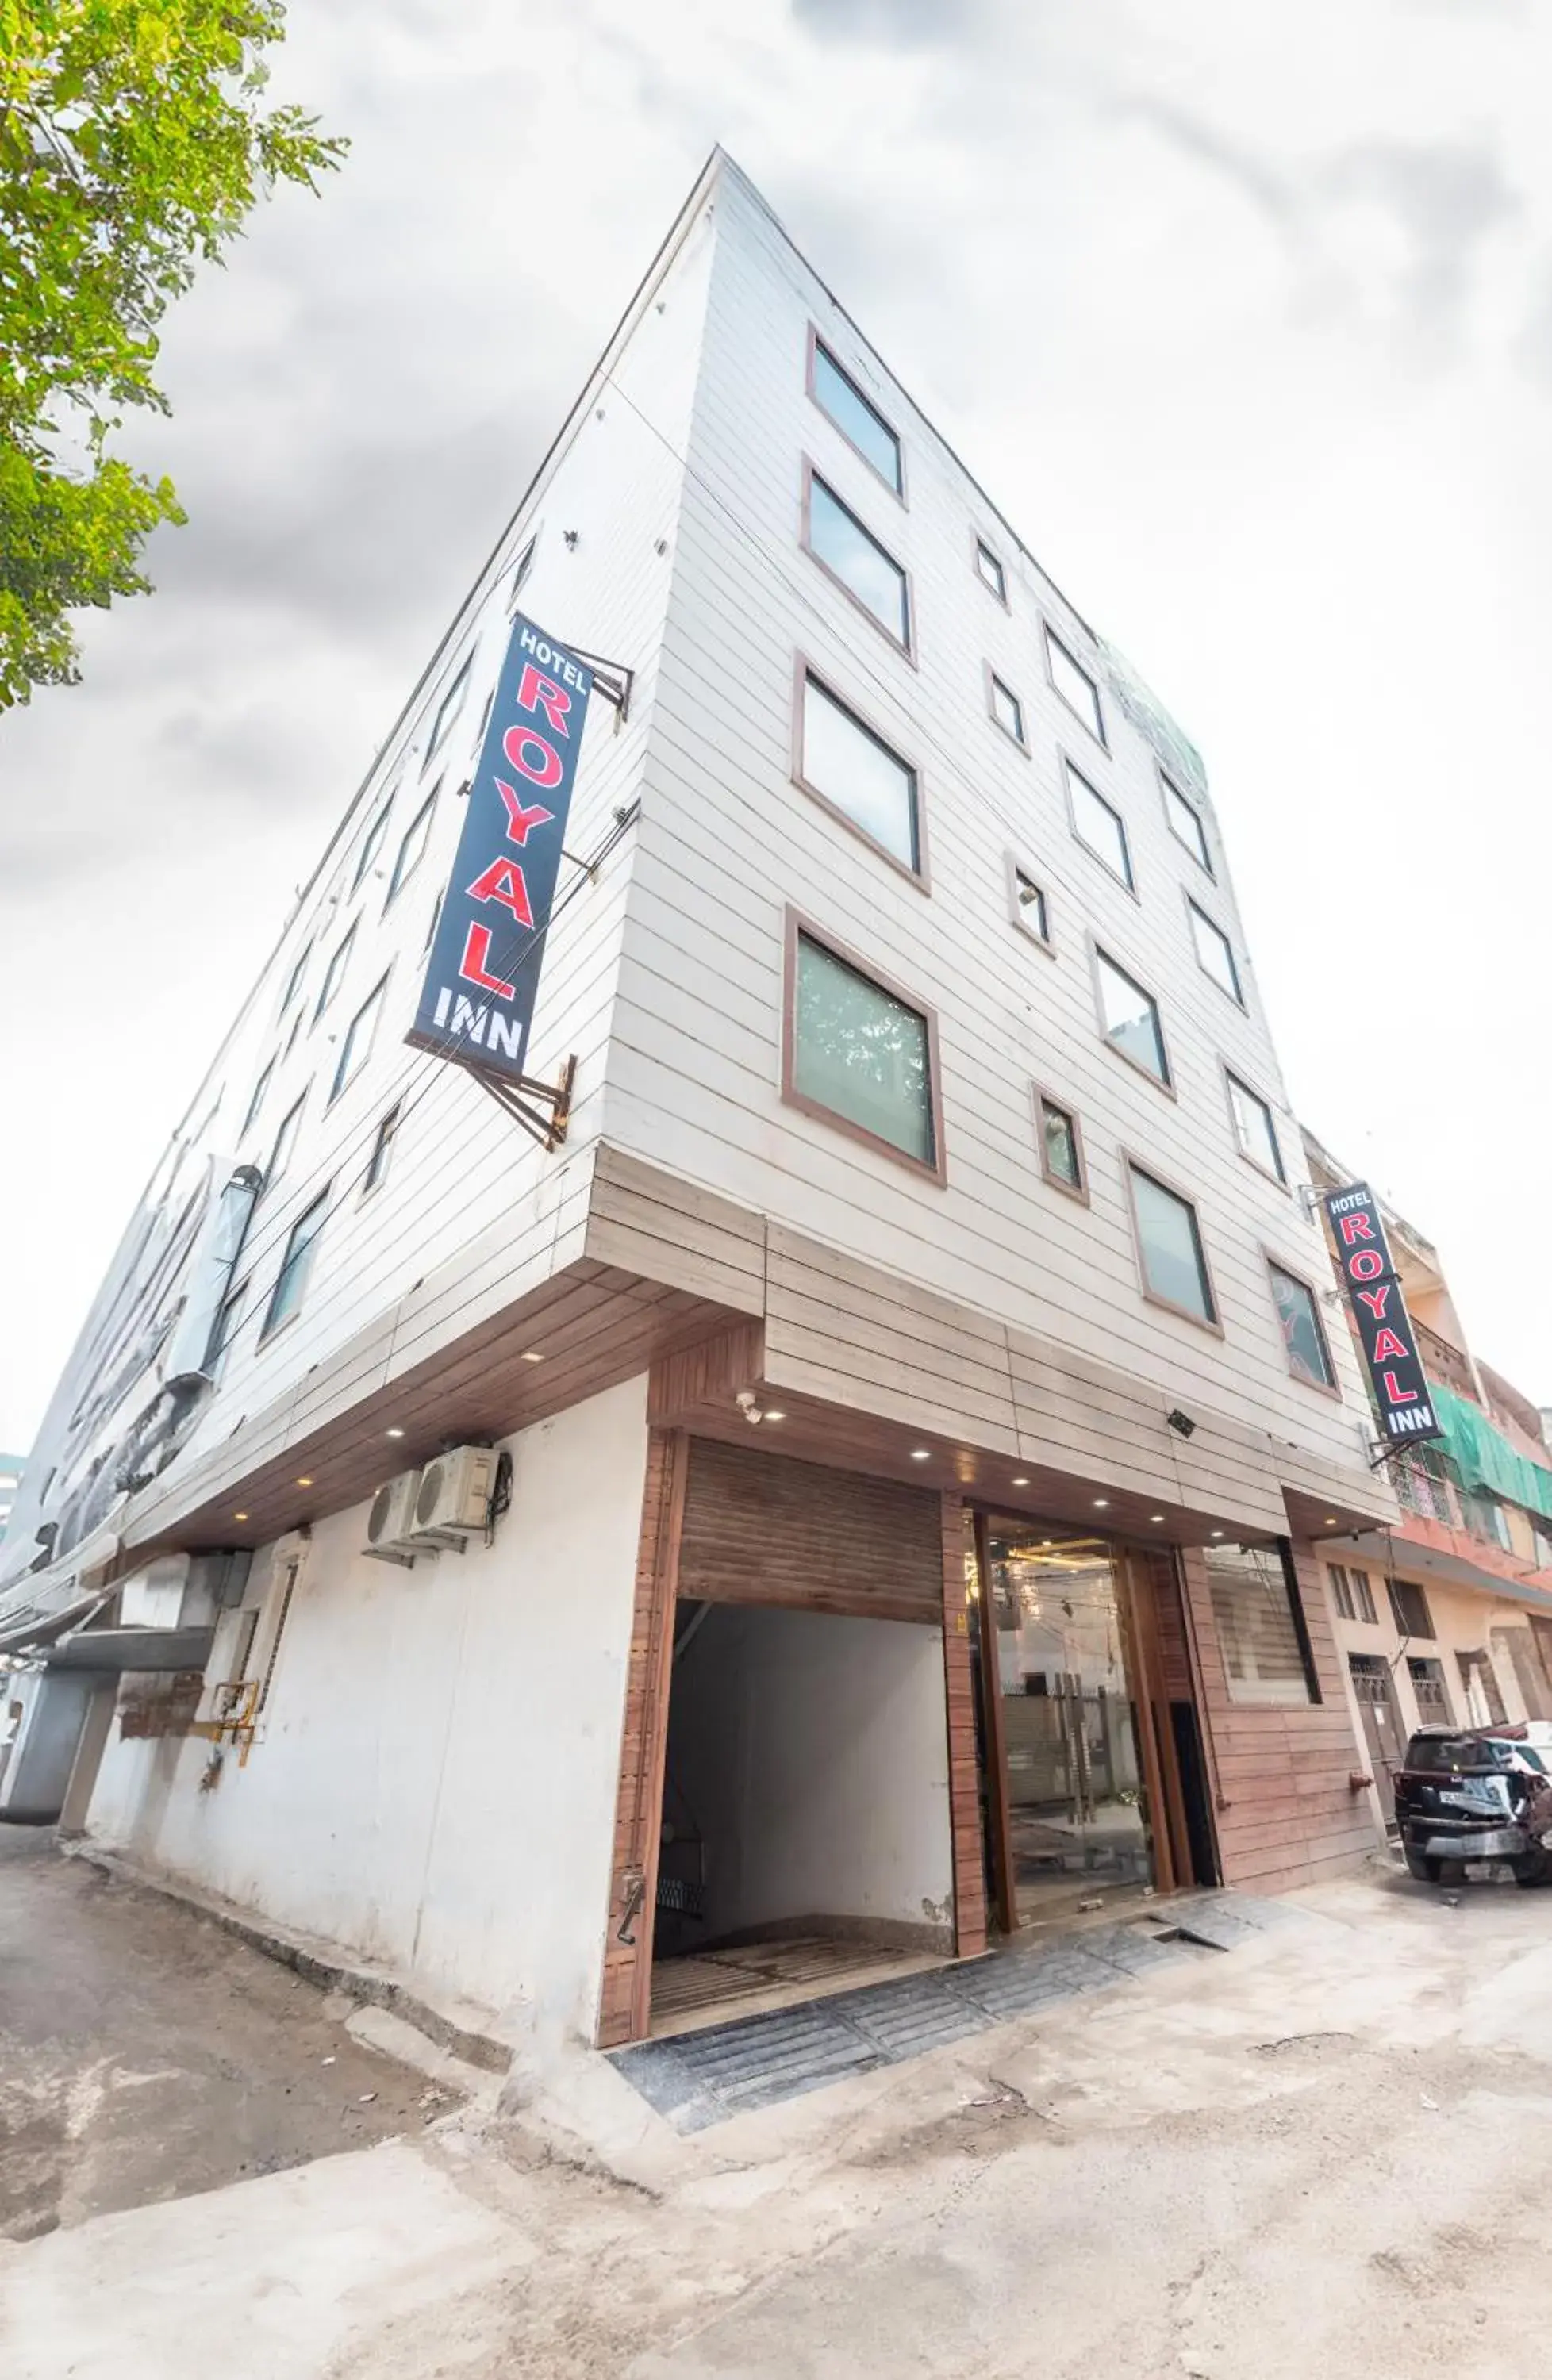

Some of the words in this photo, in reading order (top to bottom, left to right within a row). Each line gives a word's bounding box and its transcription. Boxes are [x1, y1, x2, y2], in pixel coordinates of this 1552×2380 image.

[520, 629, 587, 696] HOTEL
[459, 662, 572, 1001] ROYAL
[432, 986, 523, 1061] INN
[1331, 1192, 1371, 1215] HOTEL
[1339, 1211, 1417, 1403] ROYAL
[1387, 1407, 1432, 1434] INN
